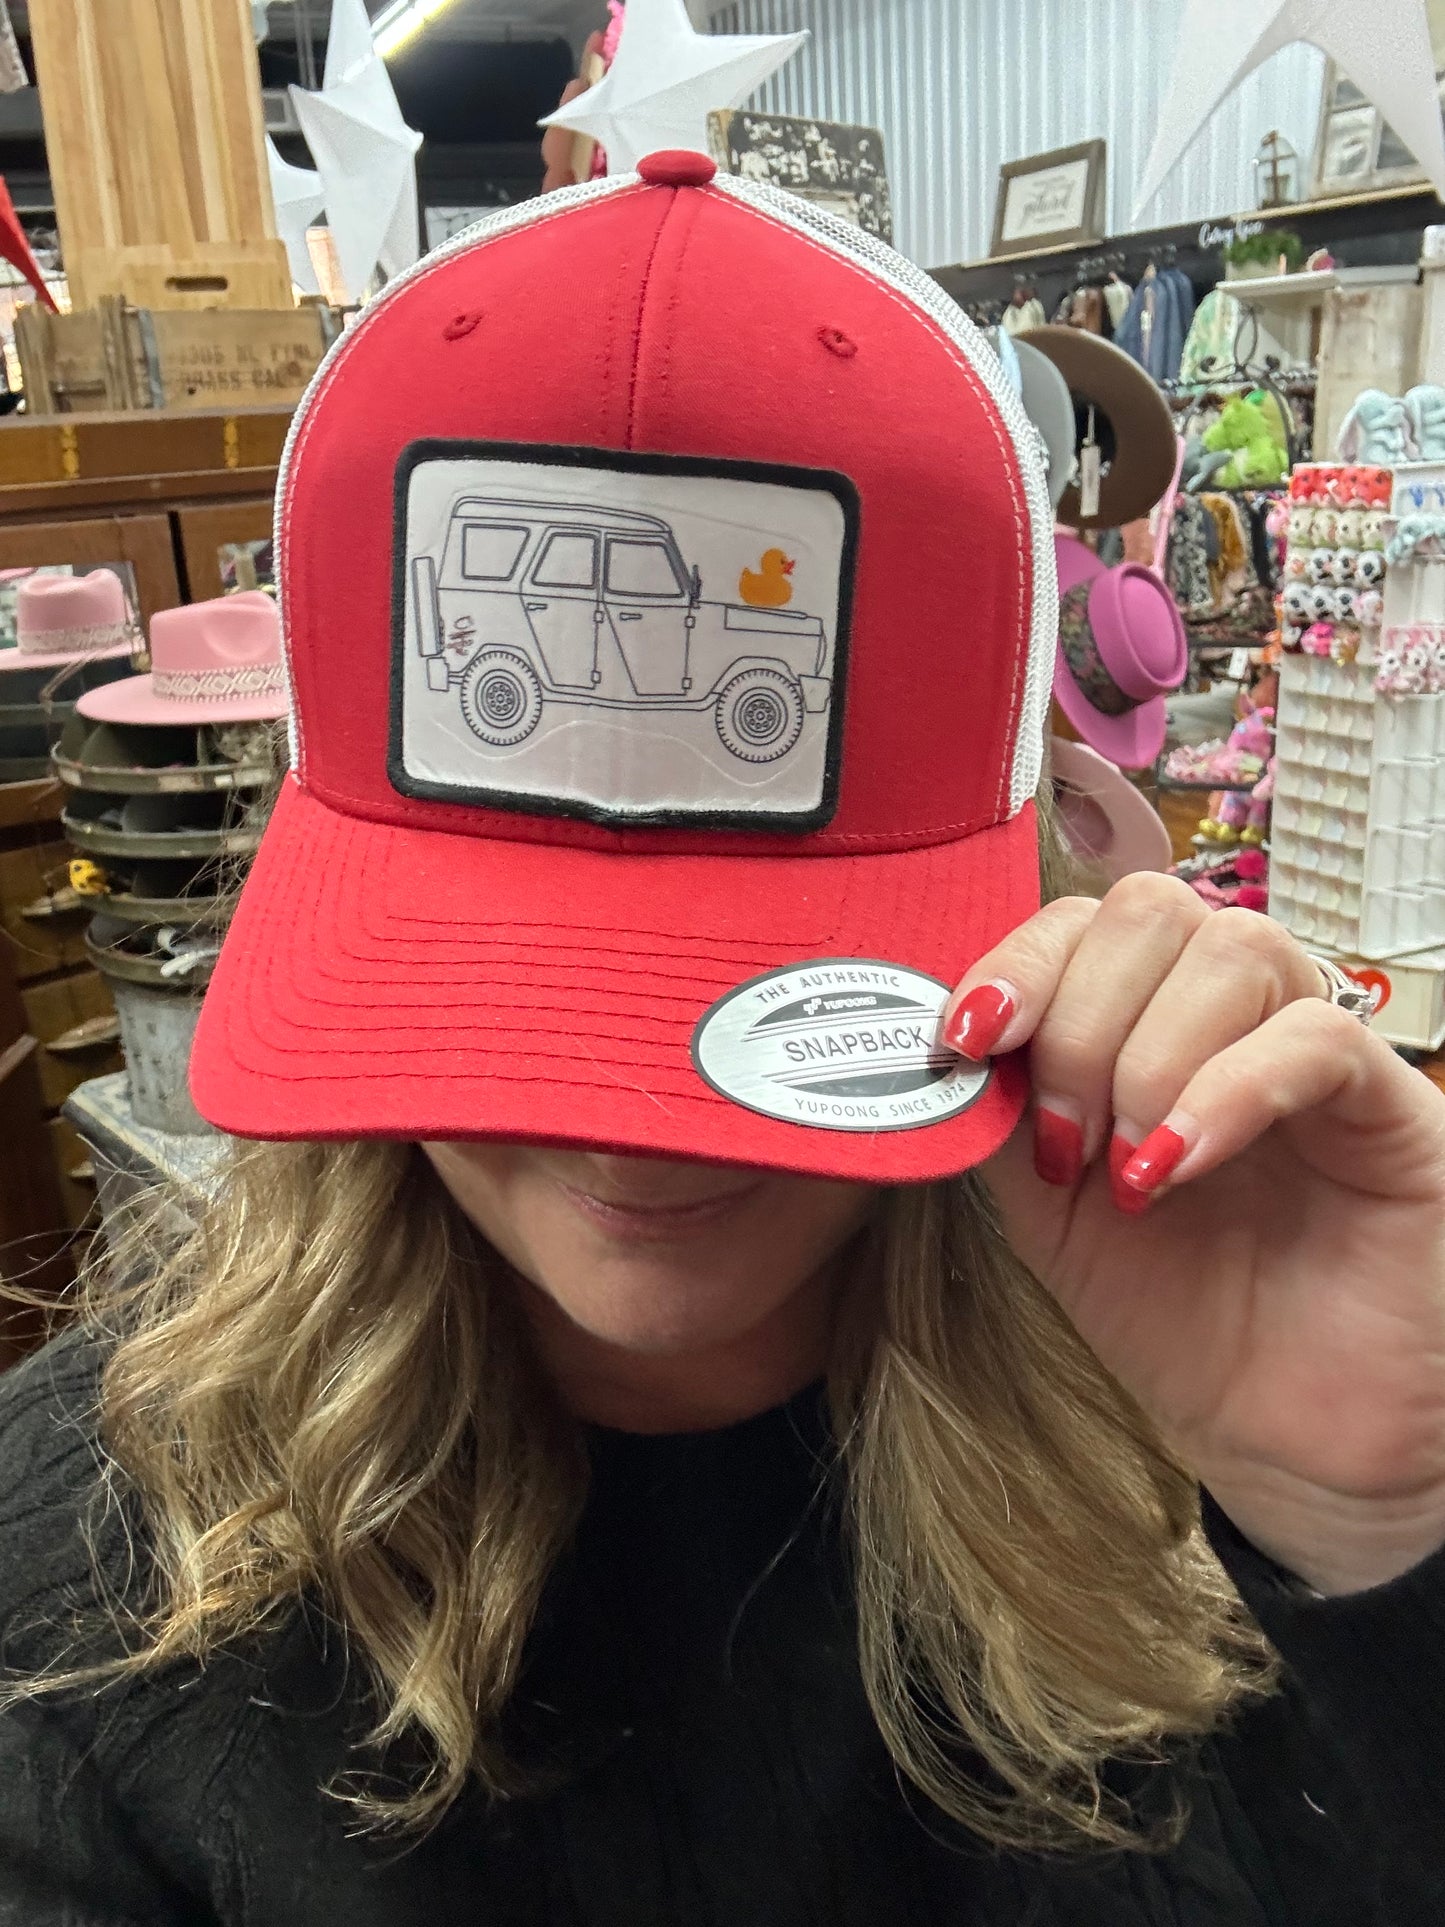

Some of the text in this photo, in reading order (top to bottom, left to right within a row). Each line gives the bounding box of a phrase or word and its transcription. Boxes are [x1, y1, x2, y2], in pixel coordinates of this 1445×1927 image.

[754, 971, 899, 1003] THE AUTHENTIC
[782, 1025, 932, 1062] SNAPBACK
[795, 1083, 966, 1118] YUPOONG SINCE 1974
